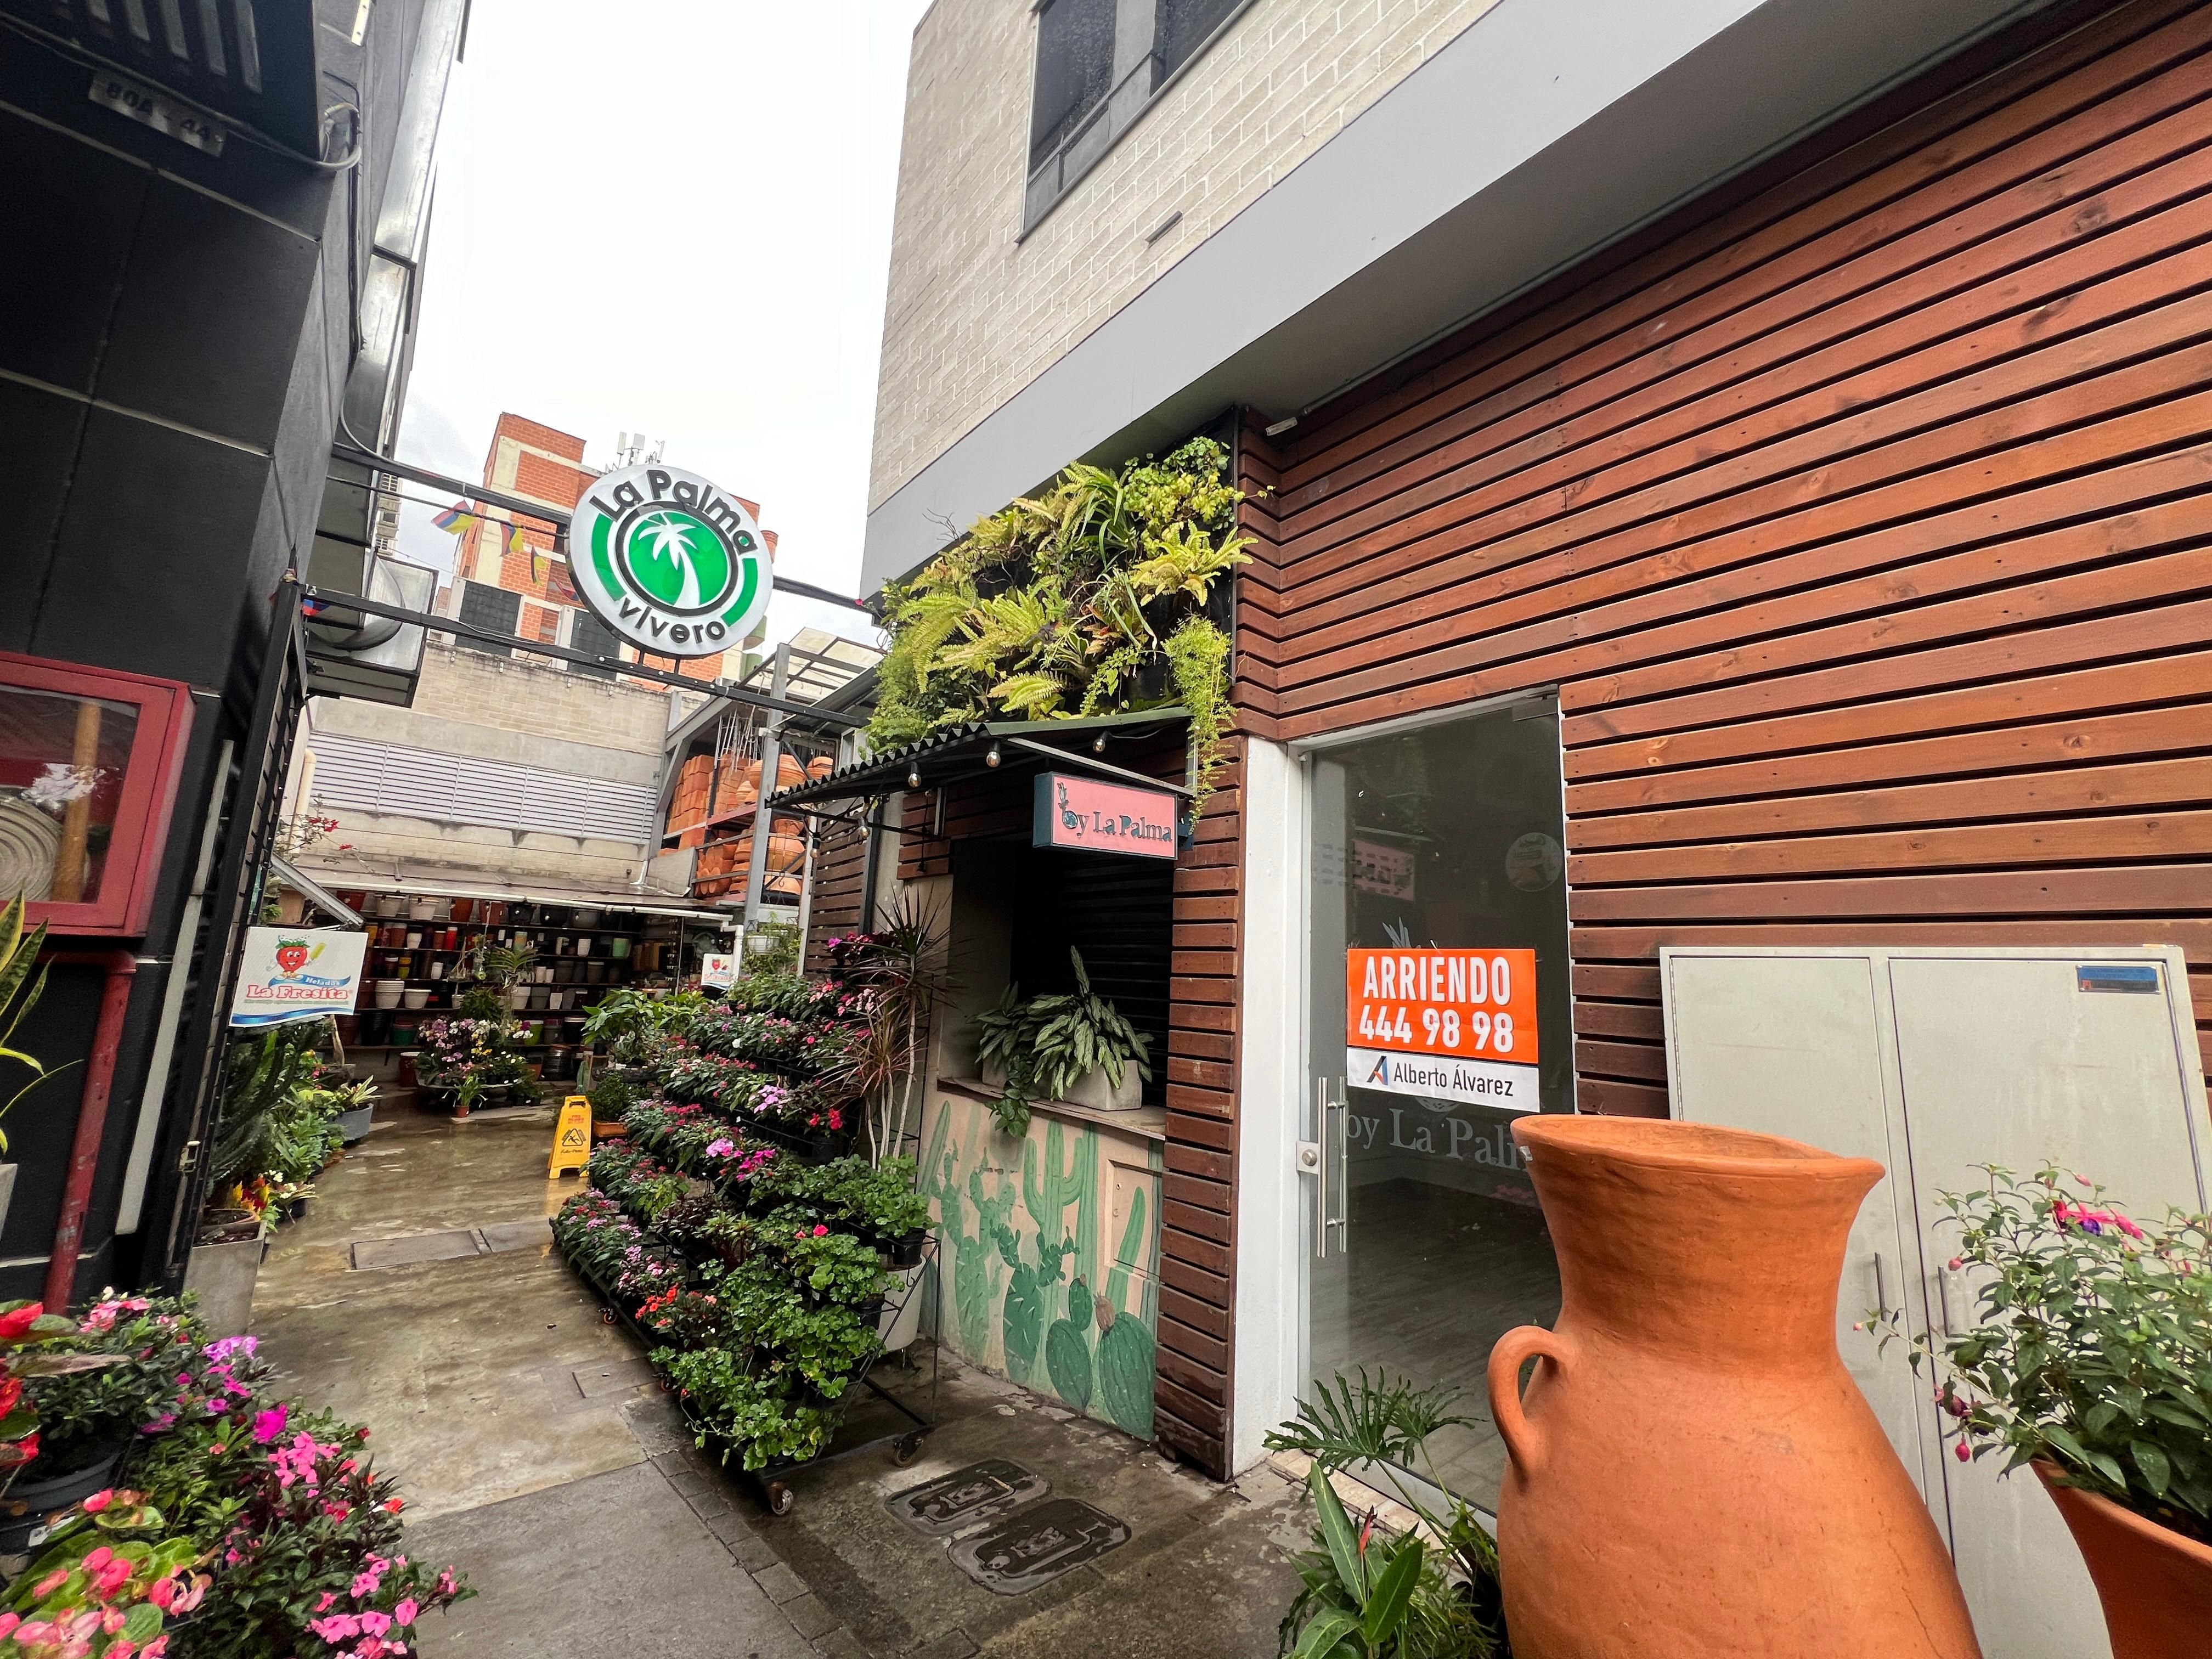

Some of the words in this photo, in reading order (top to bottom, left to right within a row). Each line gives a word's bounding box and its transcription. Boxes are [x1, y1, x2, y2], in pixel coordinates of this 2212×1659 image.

[589, 480, 645, 522] La
[646, 469, 758, 556] Palma
[1057, 787, 1090, 839] by
[1093, 811, 1116, 836] La
[1119, 815, 1173, 842] Palma
[246, 984, 273, 998] La
[276, 985, 349, 1000] Fresita
[304, 977, 340, 986] Helados
[1362, 955, 1511, 1006] ARRIENDO
[1358, 1005, 1413, 1044] 444
[1421, 1007, 1462, 1048] 98
[1471, 1011, 1515, 1053] 98
[1393, 1062, 1448, 1088] Alberto
[1452, 1064, 1514, 1097] Álvarez
[1388, 1108, 1436, 1154] La
[1445, 1116, 1528, 1172] Pal
